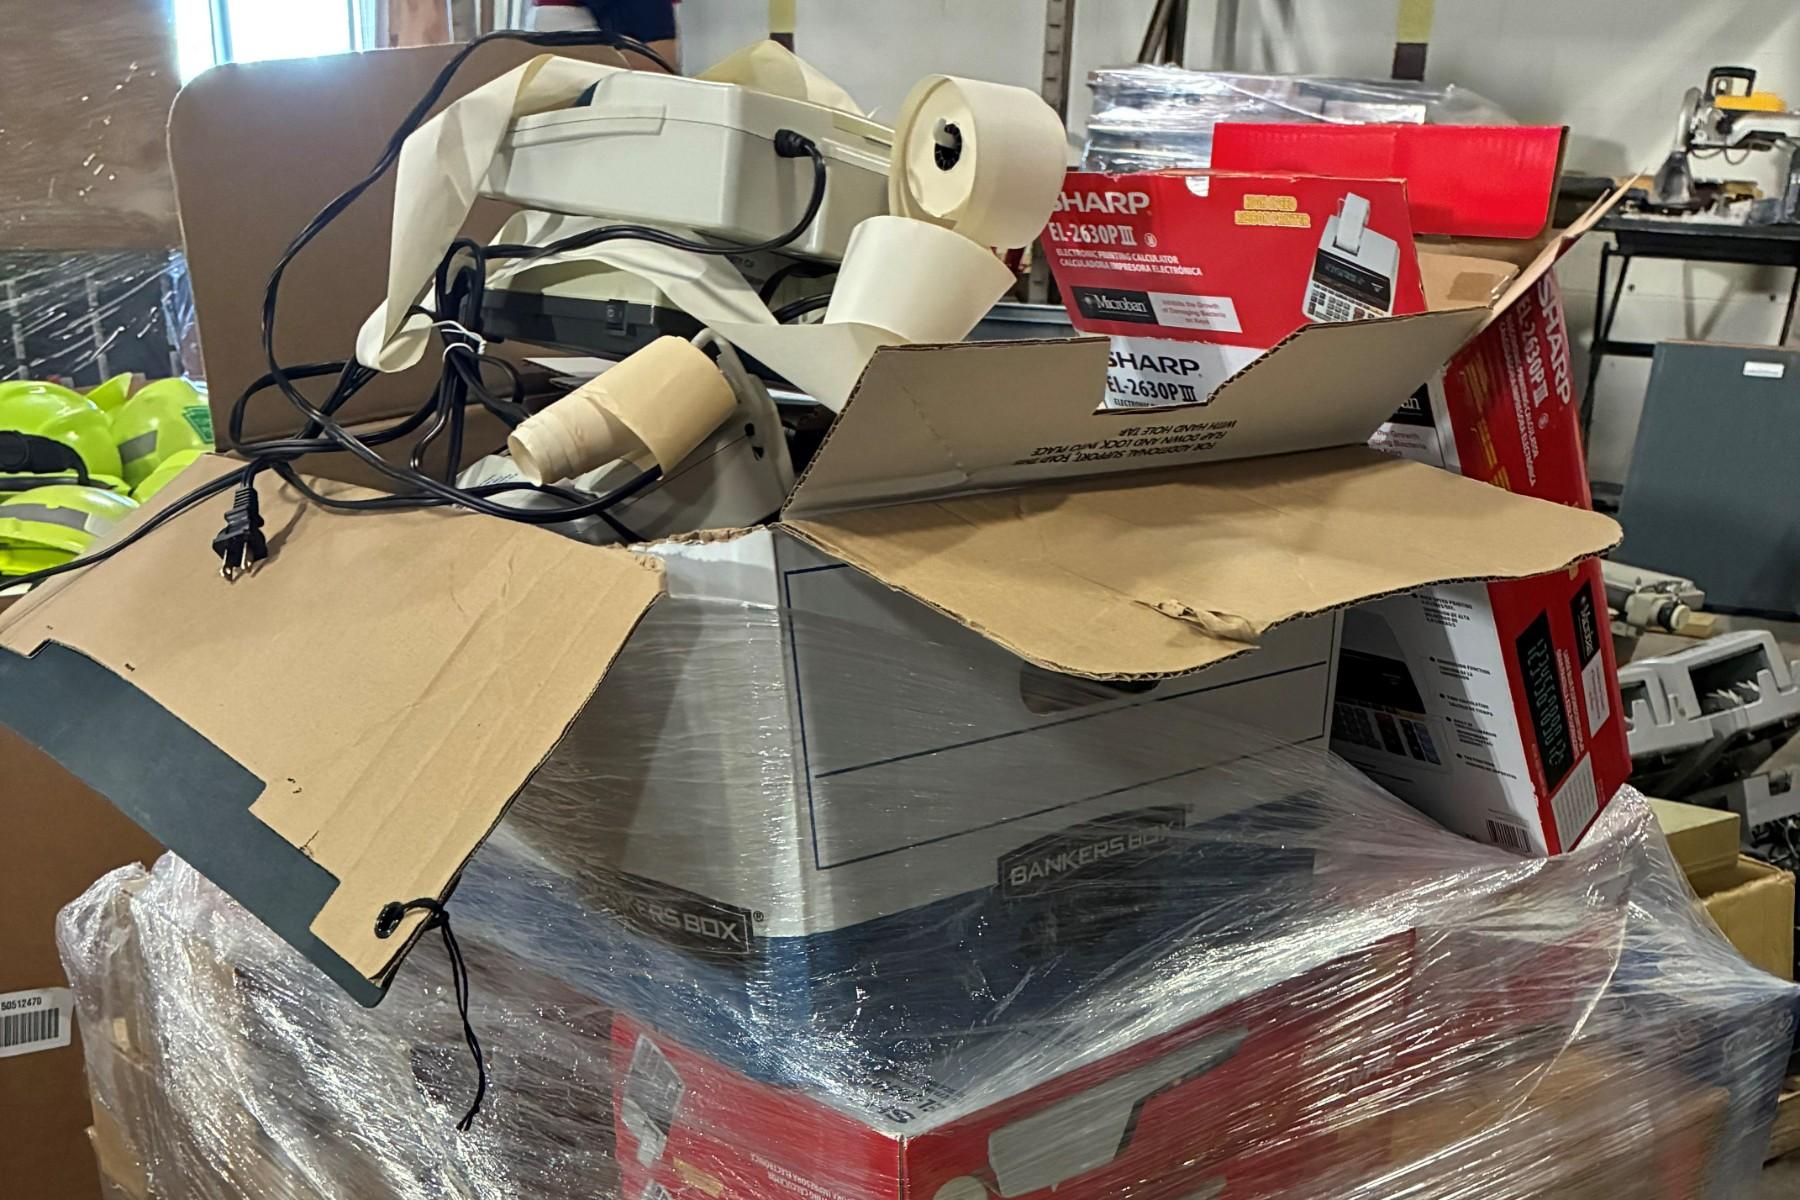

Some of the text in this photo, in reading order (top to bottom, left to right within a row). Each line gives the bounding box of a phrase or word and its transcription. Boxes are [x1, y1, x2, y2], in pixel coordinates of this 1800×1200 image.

[1053, 191, 1150, 214] SHARP
[1095, 294, 1147, 313] Microban
[1538, 268, 1571, 405] SHARP
[1108, 351, 1199, 376] SHARP
[1142, 426, 1173, 436] HOLE
[1173, 423, 1207, 434] HAND
[1102, 439, 1132, 450] LOCK
[1134, 437, 1158, 447] AND
[1164, 433, 1200, 443] DOWN
[1031, 446, 1069, 457] PLACE
[1010, 821, 1174, 886] BANKERS BOX
[683, 914, 741, 942] BOX
